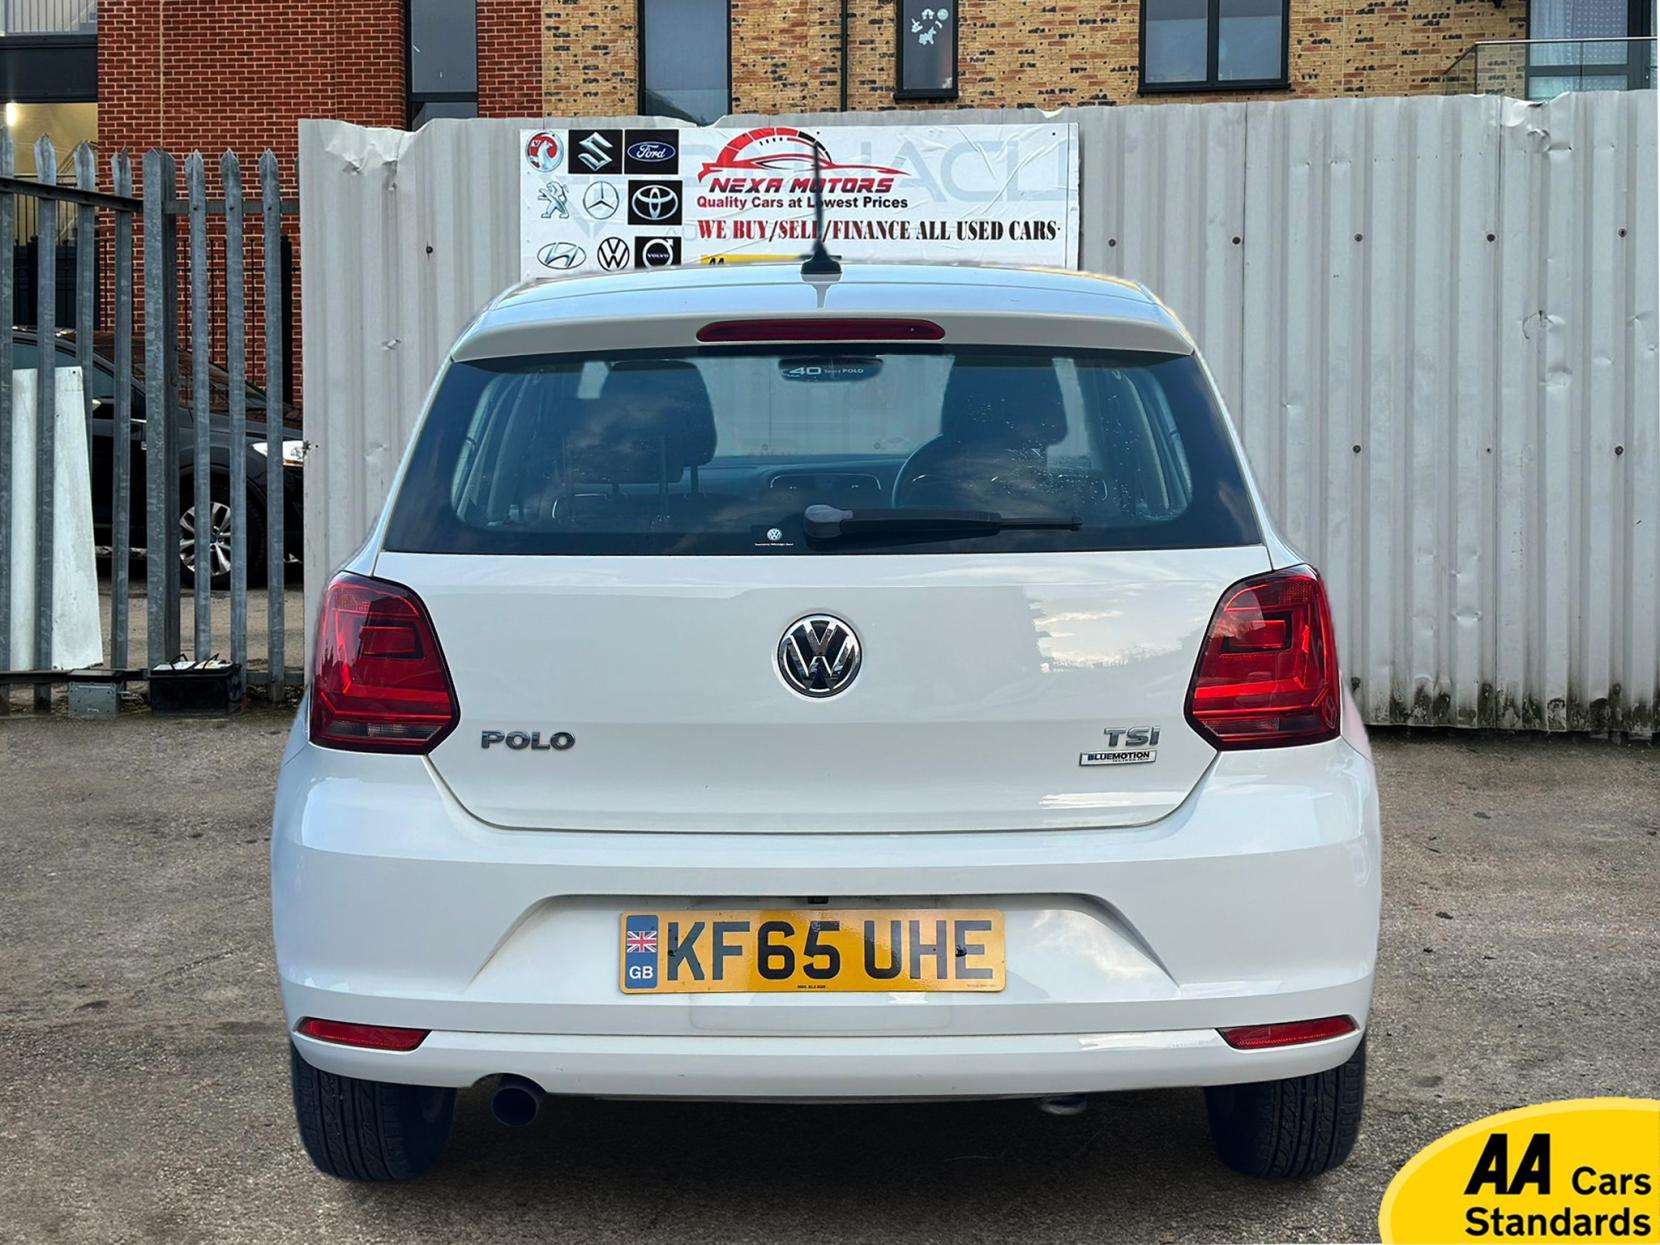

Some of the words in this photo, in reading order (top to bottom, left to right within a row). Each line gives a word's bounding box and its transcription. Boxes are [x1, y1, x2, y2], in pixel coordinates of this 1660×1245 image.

[636, 145, 666, 158] Ford
[709, 178, 784, 193] NEXA
[789, 178, 895, 193] MOTORS
[697, 196, 747, 210] Quality
[752, 196, 784, 208] Cars
[788, 197, 802, 208] at
[863, 196, 908, 208] Prices
[698, 220, 727, 239] WE
[916, 220, 950, 240] ALL
[957, 220, 1003, 240] USED
[1009, 220, 1057, 240] CARS
[481, 731, 576, 751] POLO
[1104, 727, 1160, 747] TSI
[1087, 751, 1150, 761] BLUEMOTION
[667, 921, 840, 981] KF65
[864, 920, 993, 980] UHE
[629, 965, 653, 980] GB
